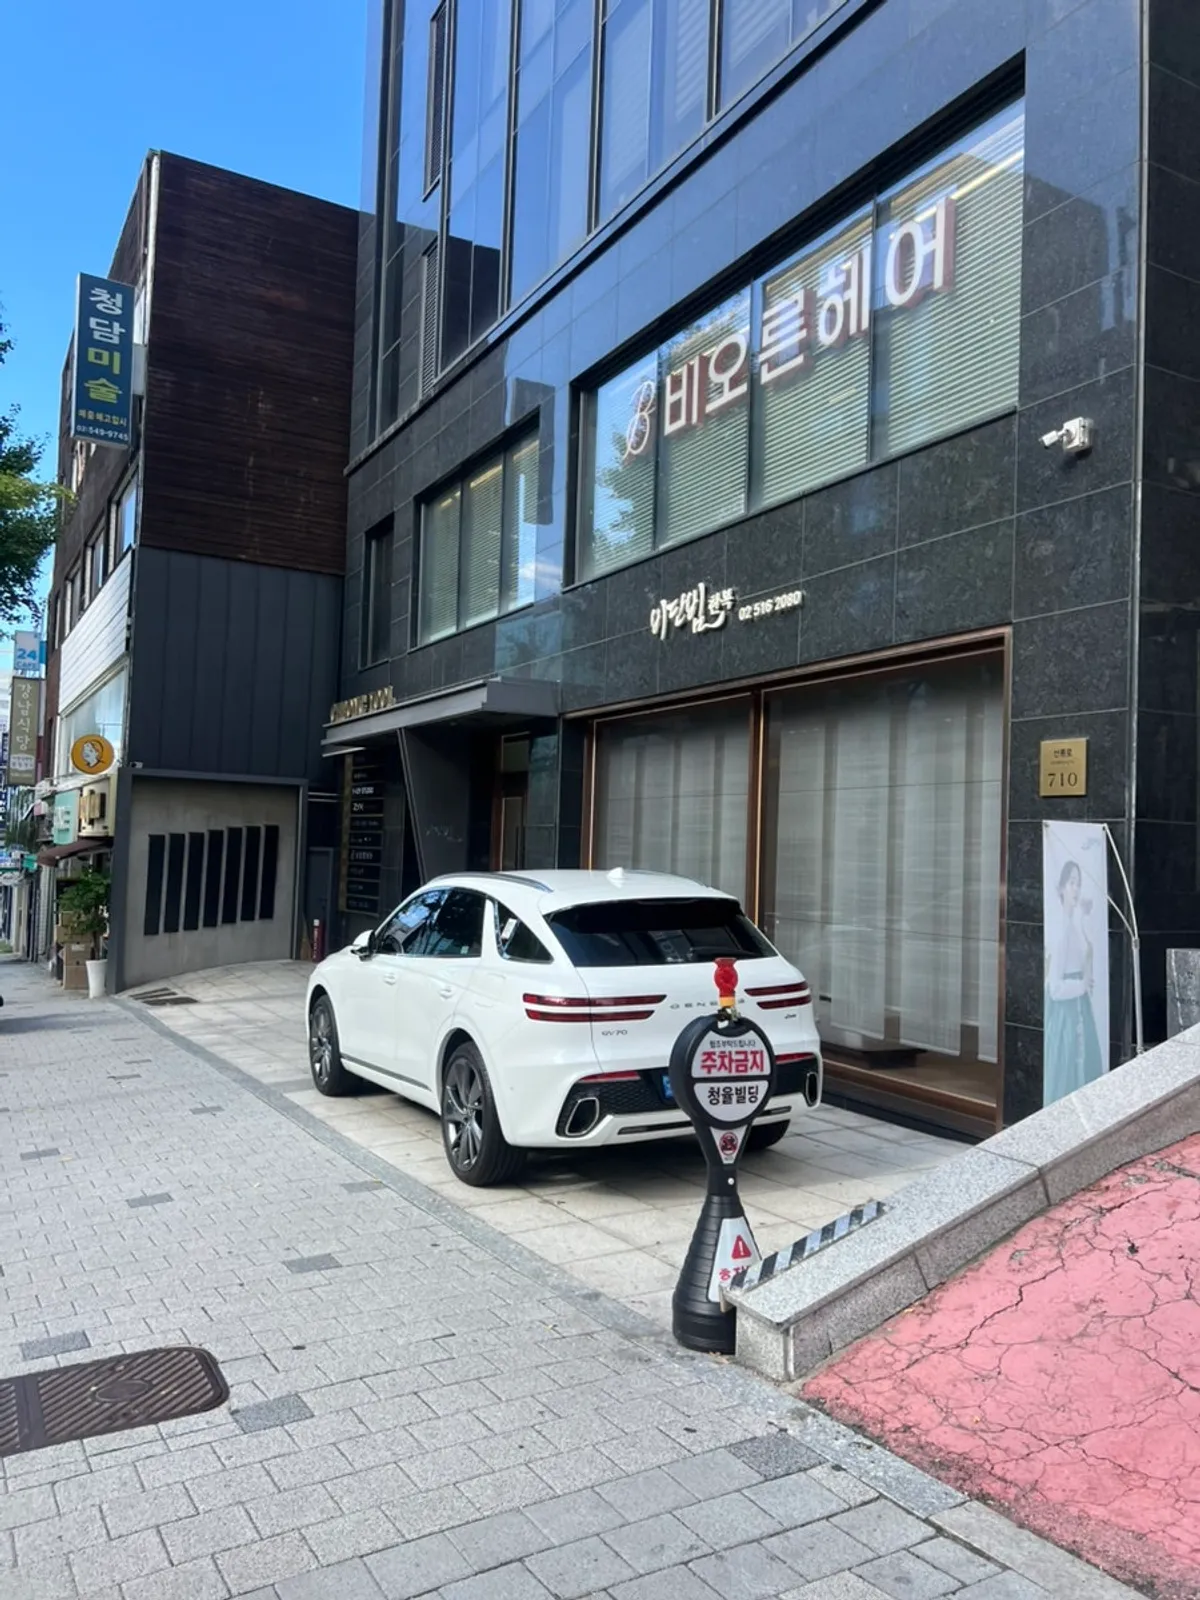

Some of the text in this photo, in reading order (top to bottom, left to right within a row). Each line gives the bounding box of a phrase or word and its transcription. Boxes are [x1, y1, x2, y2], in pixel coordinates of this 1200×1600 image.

[83, 287, 126, 404] 청담미술
[738, 605, 752, 621] 02
[753, 599, 773, 617] 516
[17, 648, 37, 660] 24
[1047, 772, 1078, 788] 710
[601, 1029, 629, 1037] GV70
[700, 1049, 764, 1075] 주차금지
[707, 1085, 759, 1106] 청율빌딩
